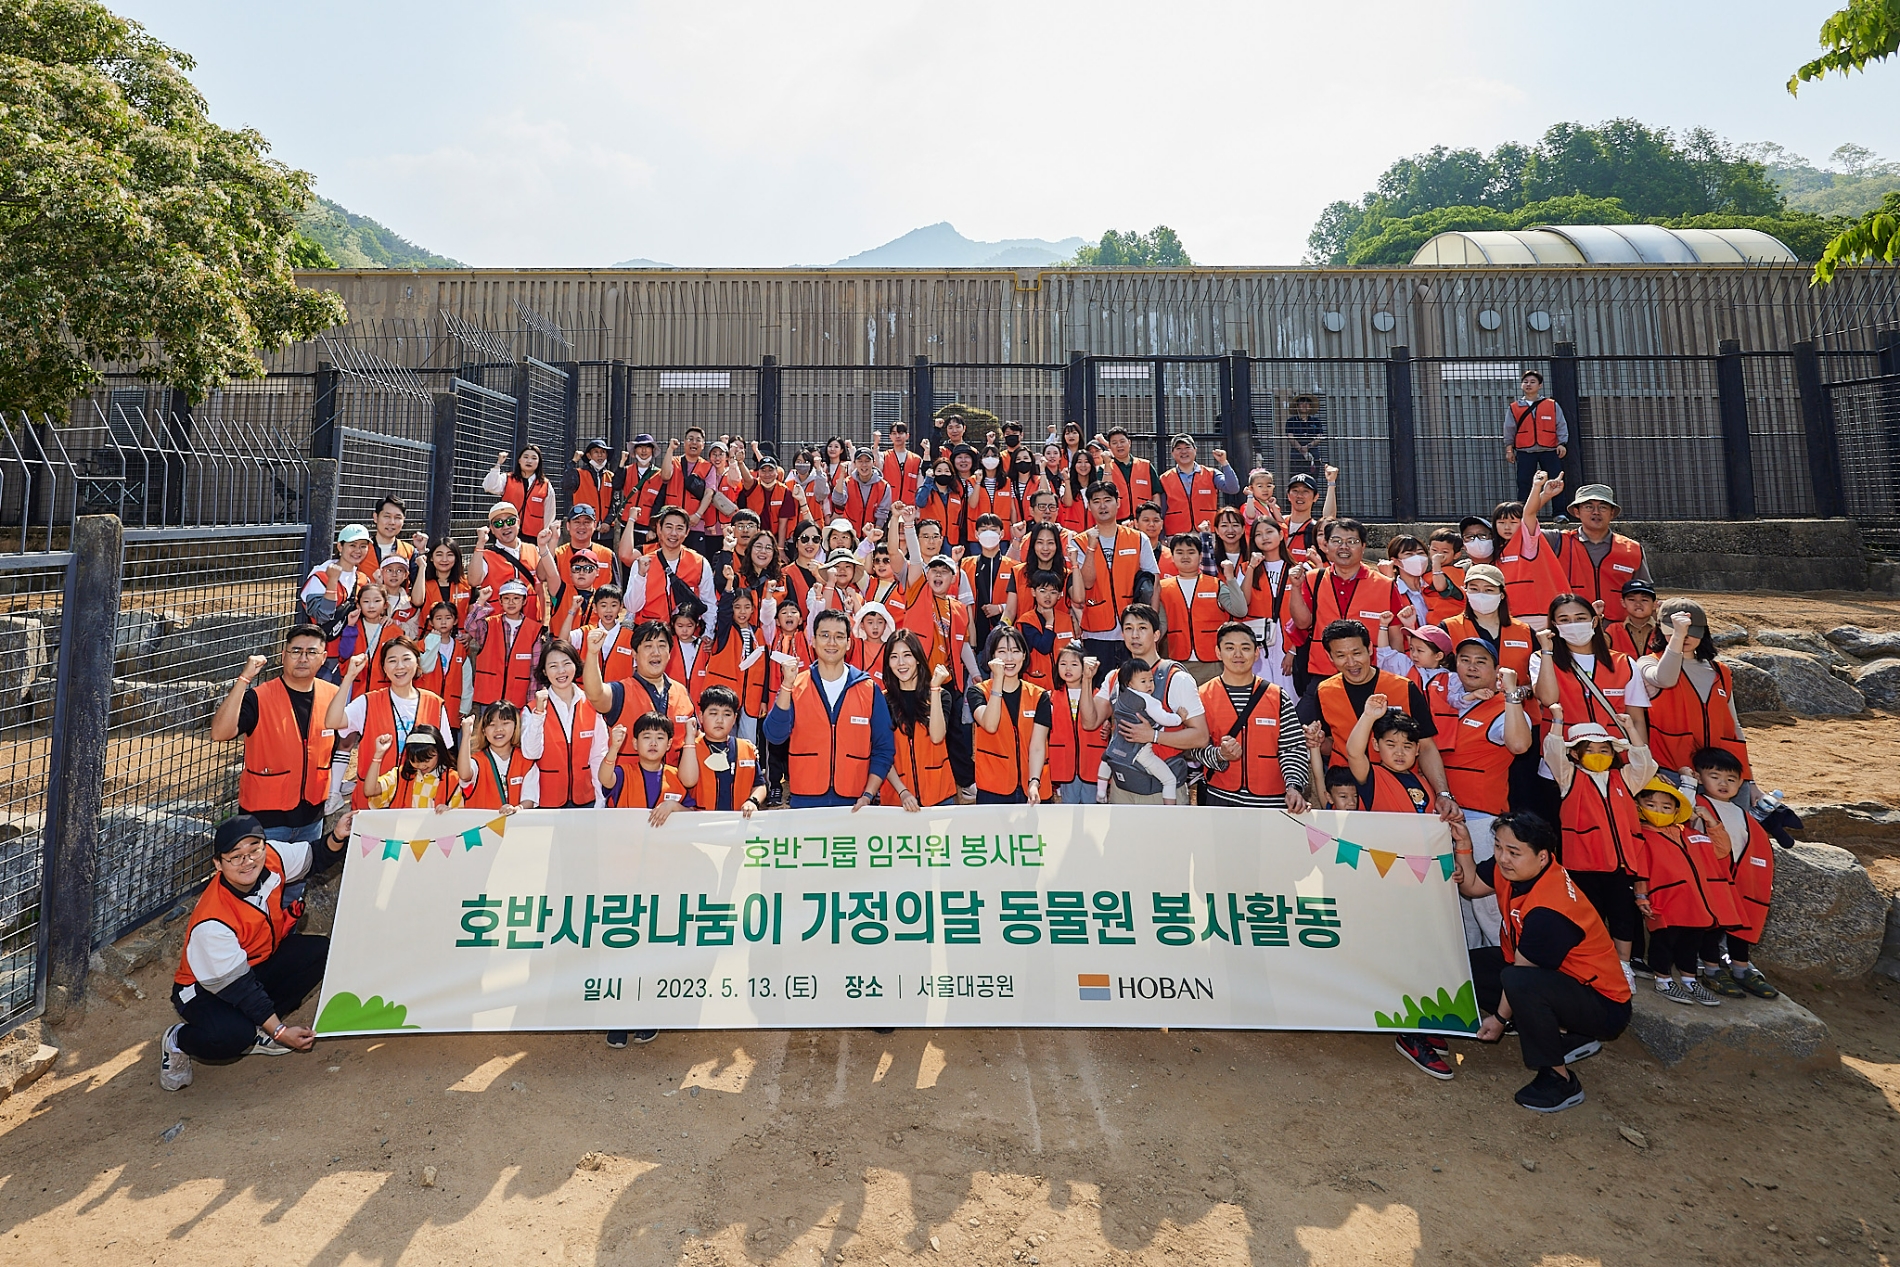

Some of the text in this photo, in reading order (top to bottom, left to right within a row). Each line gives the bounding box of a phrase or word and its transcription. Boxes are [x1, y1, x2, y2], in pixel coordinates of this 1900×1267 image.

[743, 834, 1047, 869] 호반그룹 임직원 봉사단
[455, 890, 1342, 950] 호반사랑나눔이 가정의달 동물원 봉사활동
[583, 974, 1015, 1001] 일시 2023. 5. 13. (토) 장소 서울대공원
[1118, 977, 1215, 1000] HOBAN
